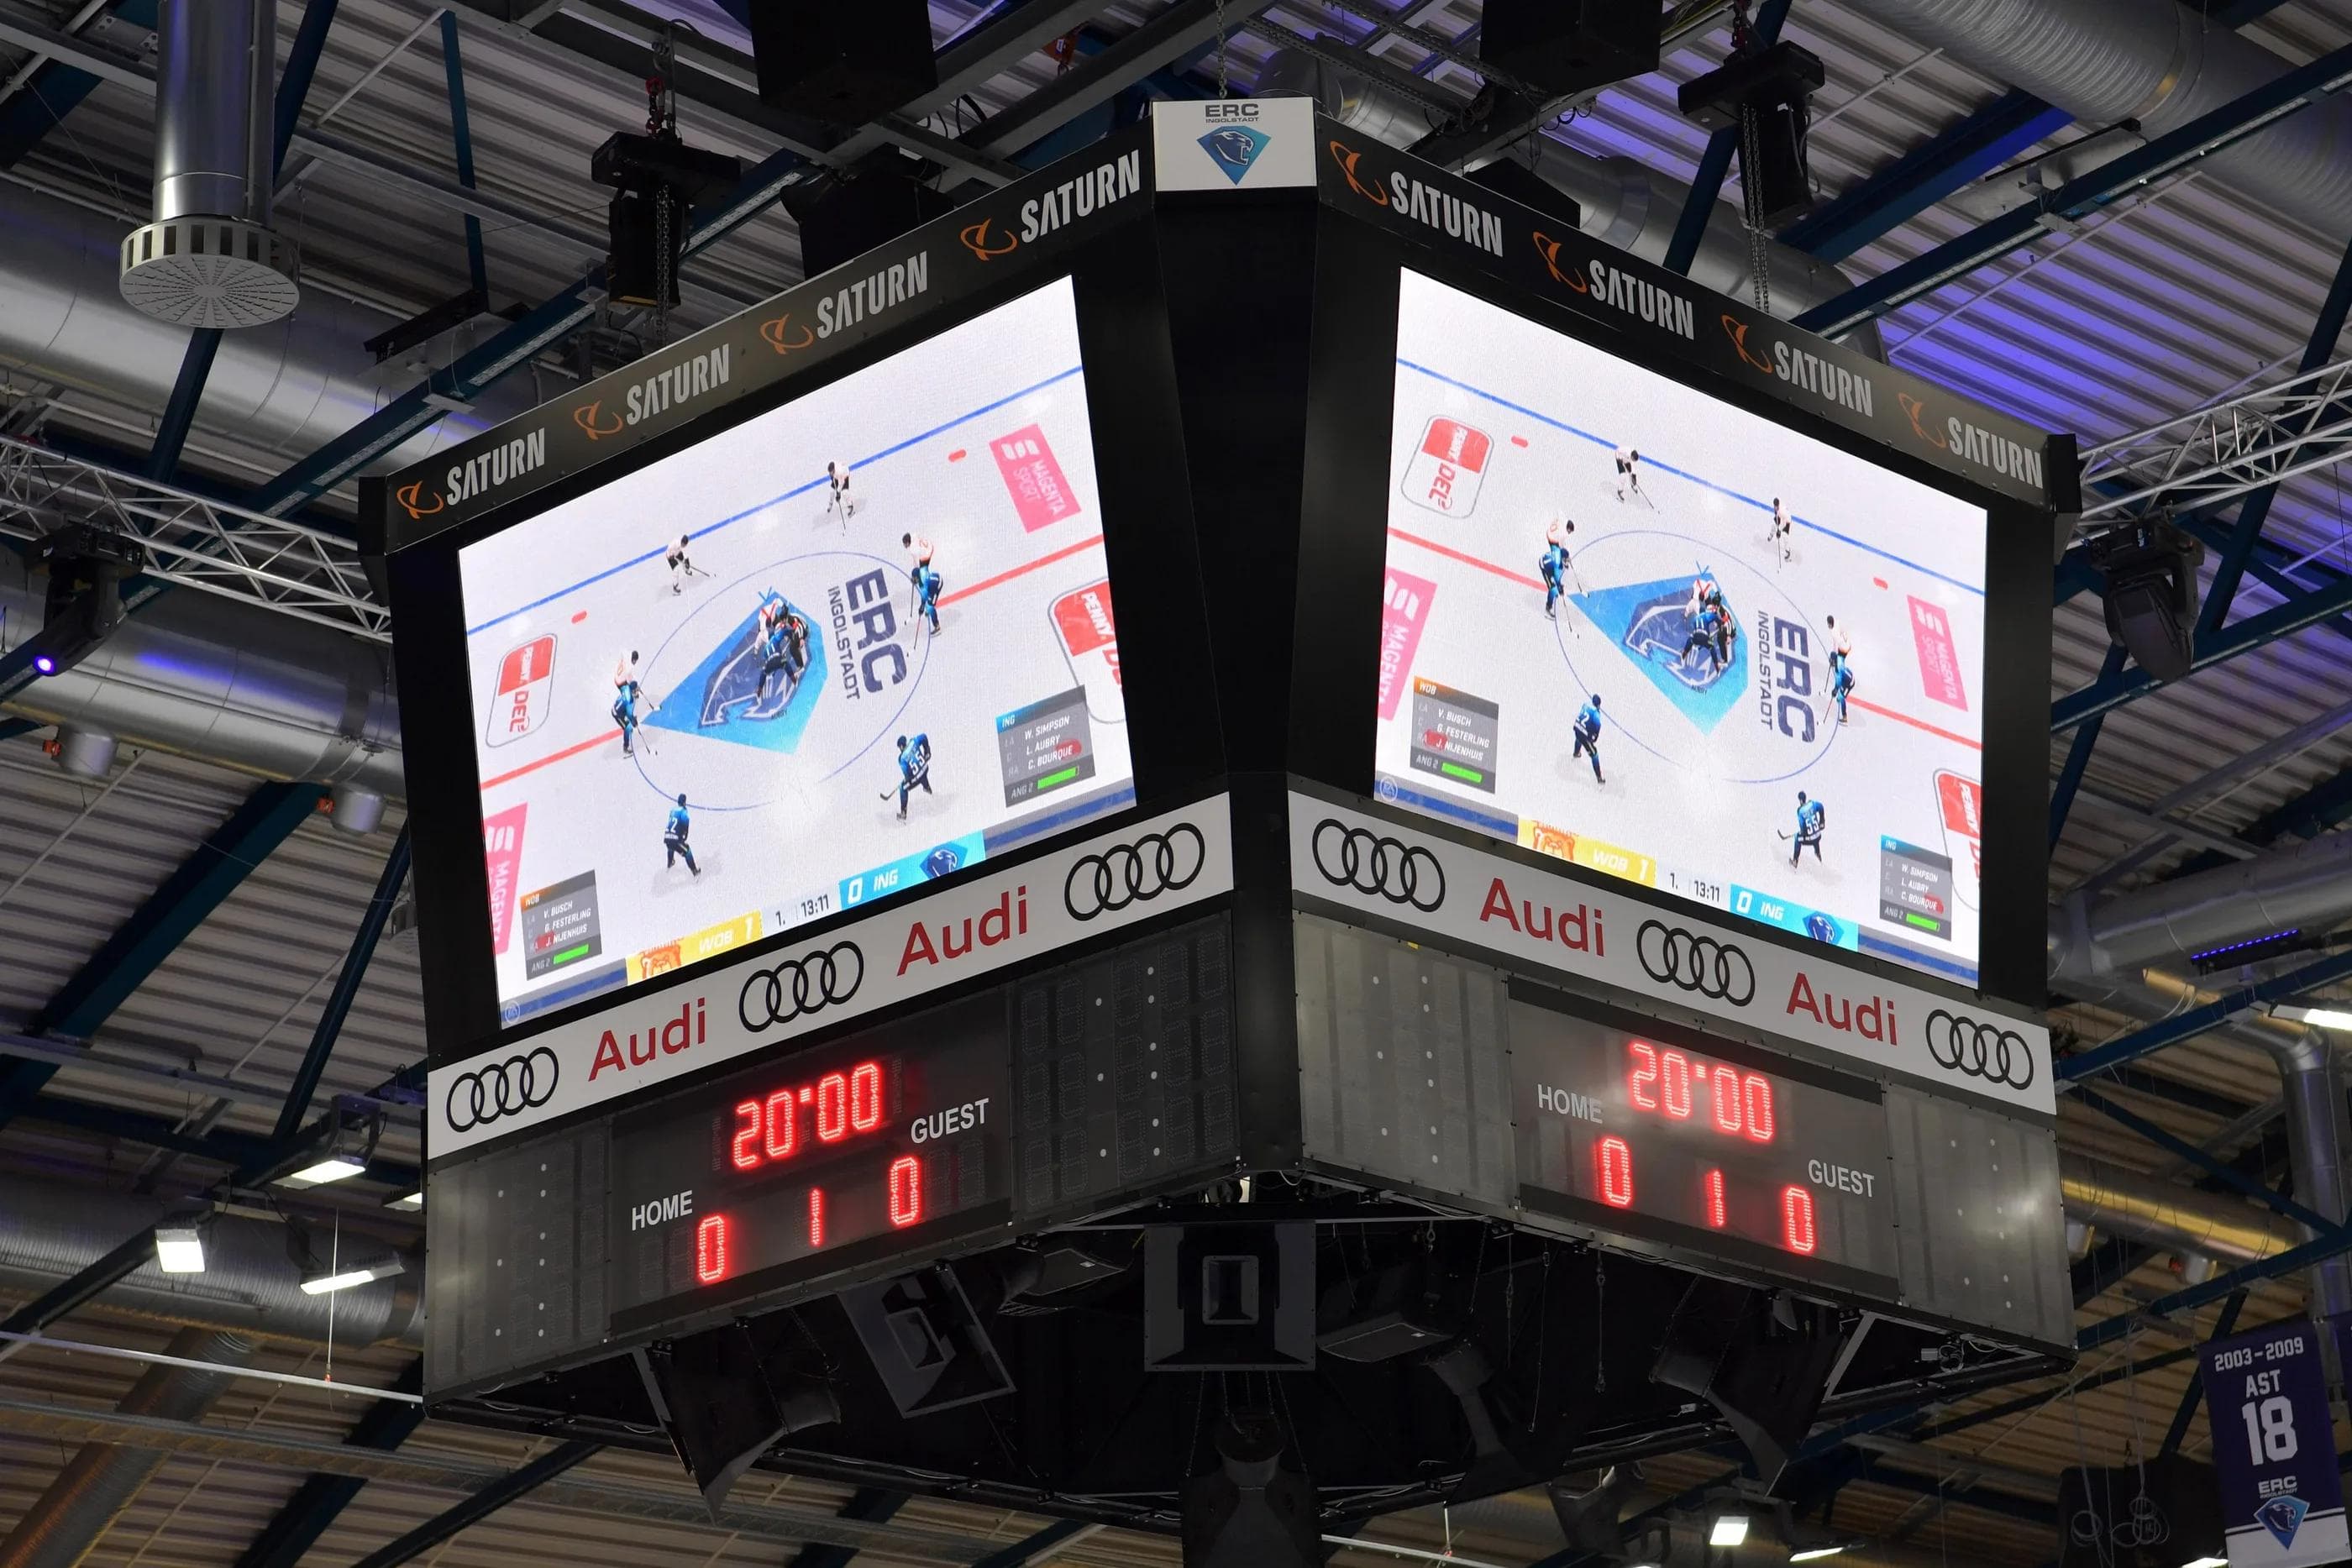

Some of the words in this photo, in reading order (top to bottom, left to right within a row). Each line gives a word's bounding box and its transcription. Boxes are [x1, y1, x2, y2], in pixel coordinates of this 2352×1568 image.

[1205, 103, 1259, 117] ERC
[446, 427, 545, 506] SATURN
[626, 343, 730, 425] SATURN
[817, 251, 927, 338] SATURN
[1021, 149, 1140, 244] SATURN
[1390, 171, 1503, 257] SATURN
[1588, 260, 1694, 340] SATURN
[1774, 341, 1872, 417] SATURN
[1948, 417, 2043, 489] SATURN
[1013, 467, 1041, 502] SPORT
[1032, 459, 1066, 516] MAGENTA
[828, 586, 860, 700] INGOLSTADT
[846, 568, 906, 694] ERC
[1758, 611, 1773, 730] INGOLSTADT
[1774, 616, 1815, 743] ERC
[1002, 715, 1015, 728] ING
[1025, 729, 1034, 741] W.
[1036, 715, 1070, 737] SIMPSON
[1446, 711, 1472, 727] BUSCH
[1035, 734, 1060, 753] AUBRY
[1445, 741, 1483, 761] NIJENHUIS
[1446, 726, 1490, 748] FESTERLING
[1037, 745, 1073, 767] BOURQUE
[1011, 784, 1026, 799] ANG
[1885, 839, 1897, 851] ING
[1593, 848, 1630, 873] WOB
[1640, 858, 1649, 881] 1
[1670, 873, 1678, 890] 1.
[1693, 880, 1720, 902] 13:11
[1736, 890, 1752, 914] 0
[1760, 901, 1785, 921] ING
[1908, 879, 1929, 894] AUBRY
[1910, 866, 1939, 883] SIMPSON
[551, 900, 573, 917] BUSCH
[552, 908, 591, 930] FESTERLING
[699, 929, 734, 954] WOB
[744, 916, 754, 941] 1
[775, 911, 786, 927] 1.
[801, 894, 830, 918] 13:11
[848, 876, 864, 905] 0
[873, 868, 899, 892] ING
[1908, 893, 1938, 911] BOURQUE
[553, 924, 588, 944] NIJENHUIS
[1480, 878, 1605, 957] Audi
[1786, 972, 1898, 1046] Audi
[588, 997, 705, 1082] Audi
[897, 887, 1028, 977] Audi
[911, 1098, 989, 1144] GUEST
[1537, 1083, 1604, 1125] HOME
[1602, 1137, 1631, 1206] 0
[1710, 1169, 1725, 1227] 1
[1786, 1186, 1813, 1253] 0
[1808, 1159, 1874, 1198] GUEST
[632, 1189, 693, 1231] HOME
[698, 1214, 726, 1282] 0
[810, 1188, 822, 1245] 1
[890, 1156, 919, 1226] 0
[2245, 1369, 2281, 1398] AST
[2242, 1395, 2298, 1466] 18
[2258, 1476, 2297, 1494] ERC
